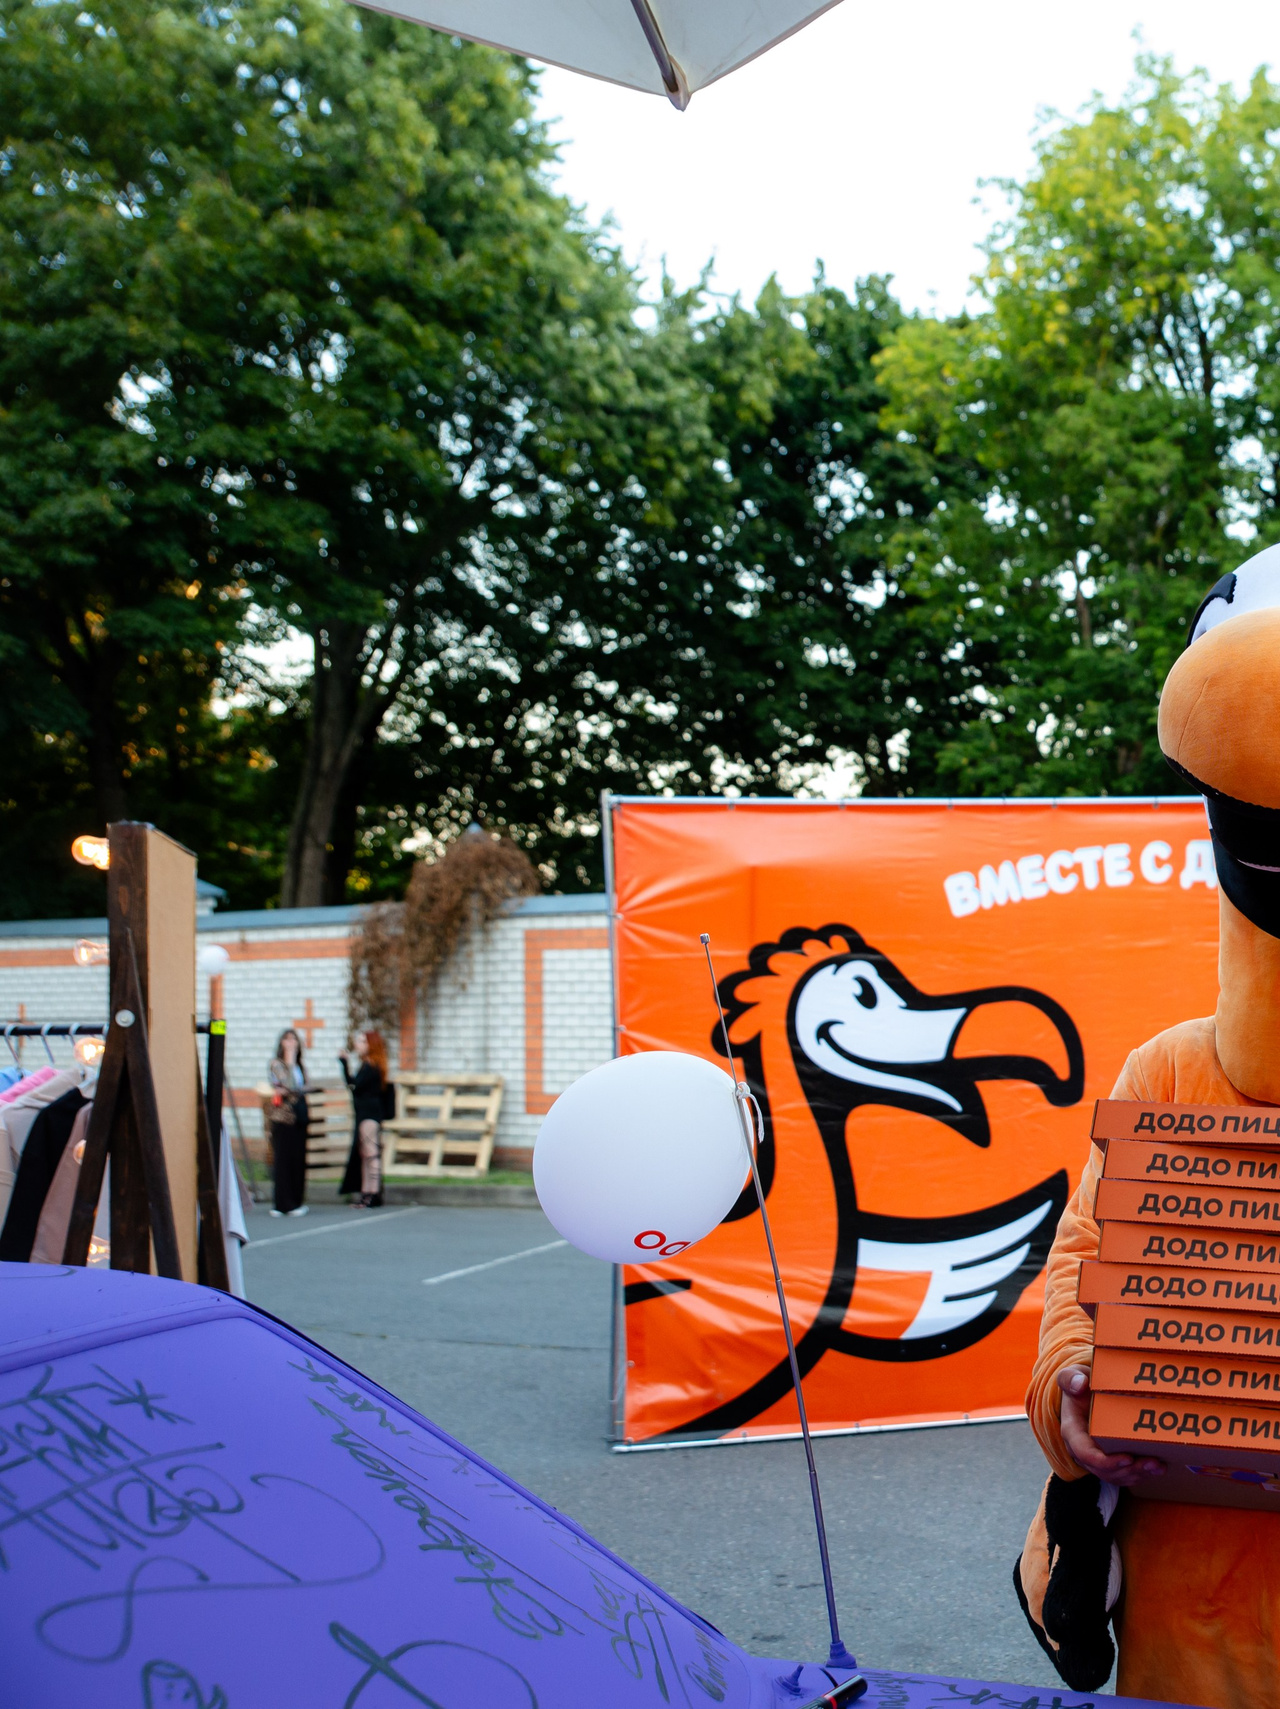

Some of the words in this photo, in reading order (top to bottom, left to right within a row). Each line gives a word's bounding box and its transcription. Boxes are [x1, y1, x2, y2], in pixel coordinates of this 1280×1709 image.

[944, 843, 1133, 917] ВМЕСТЕ
[1140, 840, 1173, 884] С
[1133, 1112, 1215, 1136] ДОДО
[1146, 1153, 1231, 1178] ДОДО
[1138, 1194, 1223, 1219] ДОДО
[1143, 1236, 1228, 1261] ДОДО
[1121, 1275, 1206, 1299] ДОДО
[1138, 1318, 1225, 1344] ДОДО
[1134, 1362, 1222, 1388] ДОДО
[1133, 1409, 1222, 1437] ДОДО
